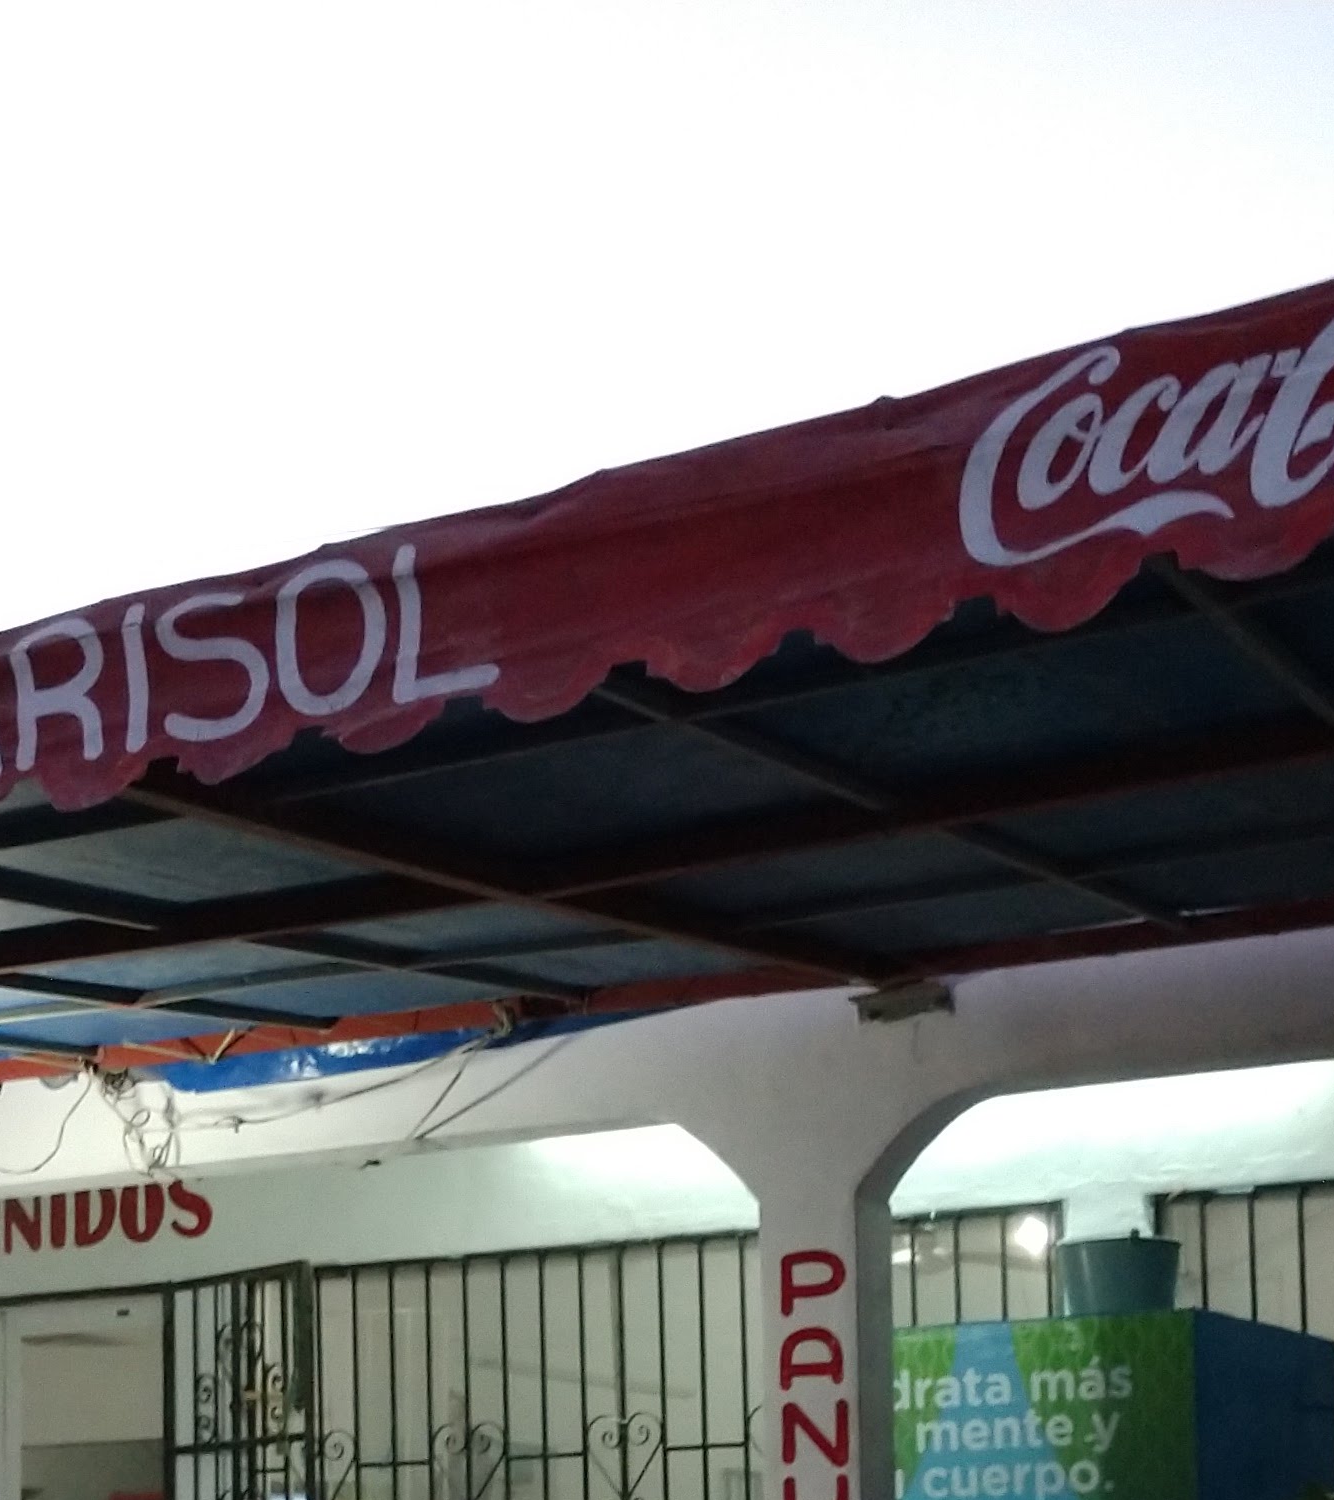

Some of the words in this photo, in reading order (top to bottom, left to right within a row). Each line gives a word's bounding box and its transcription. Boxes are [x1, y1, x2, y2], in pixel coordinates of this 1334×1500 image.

[1030, 1355, 1134, 1402] más
[916, 1408, 1074, 1454] mente
[1087, 1411, 1122, 1454] y
